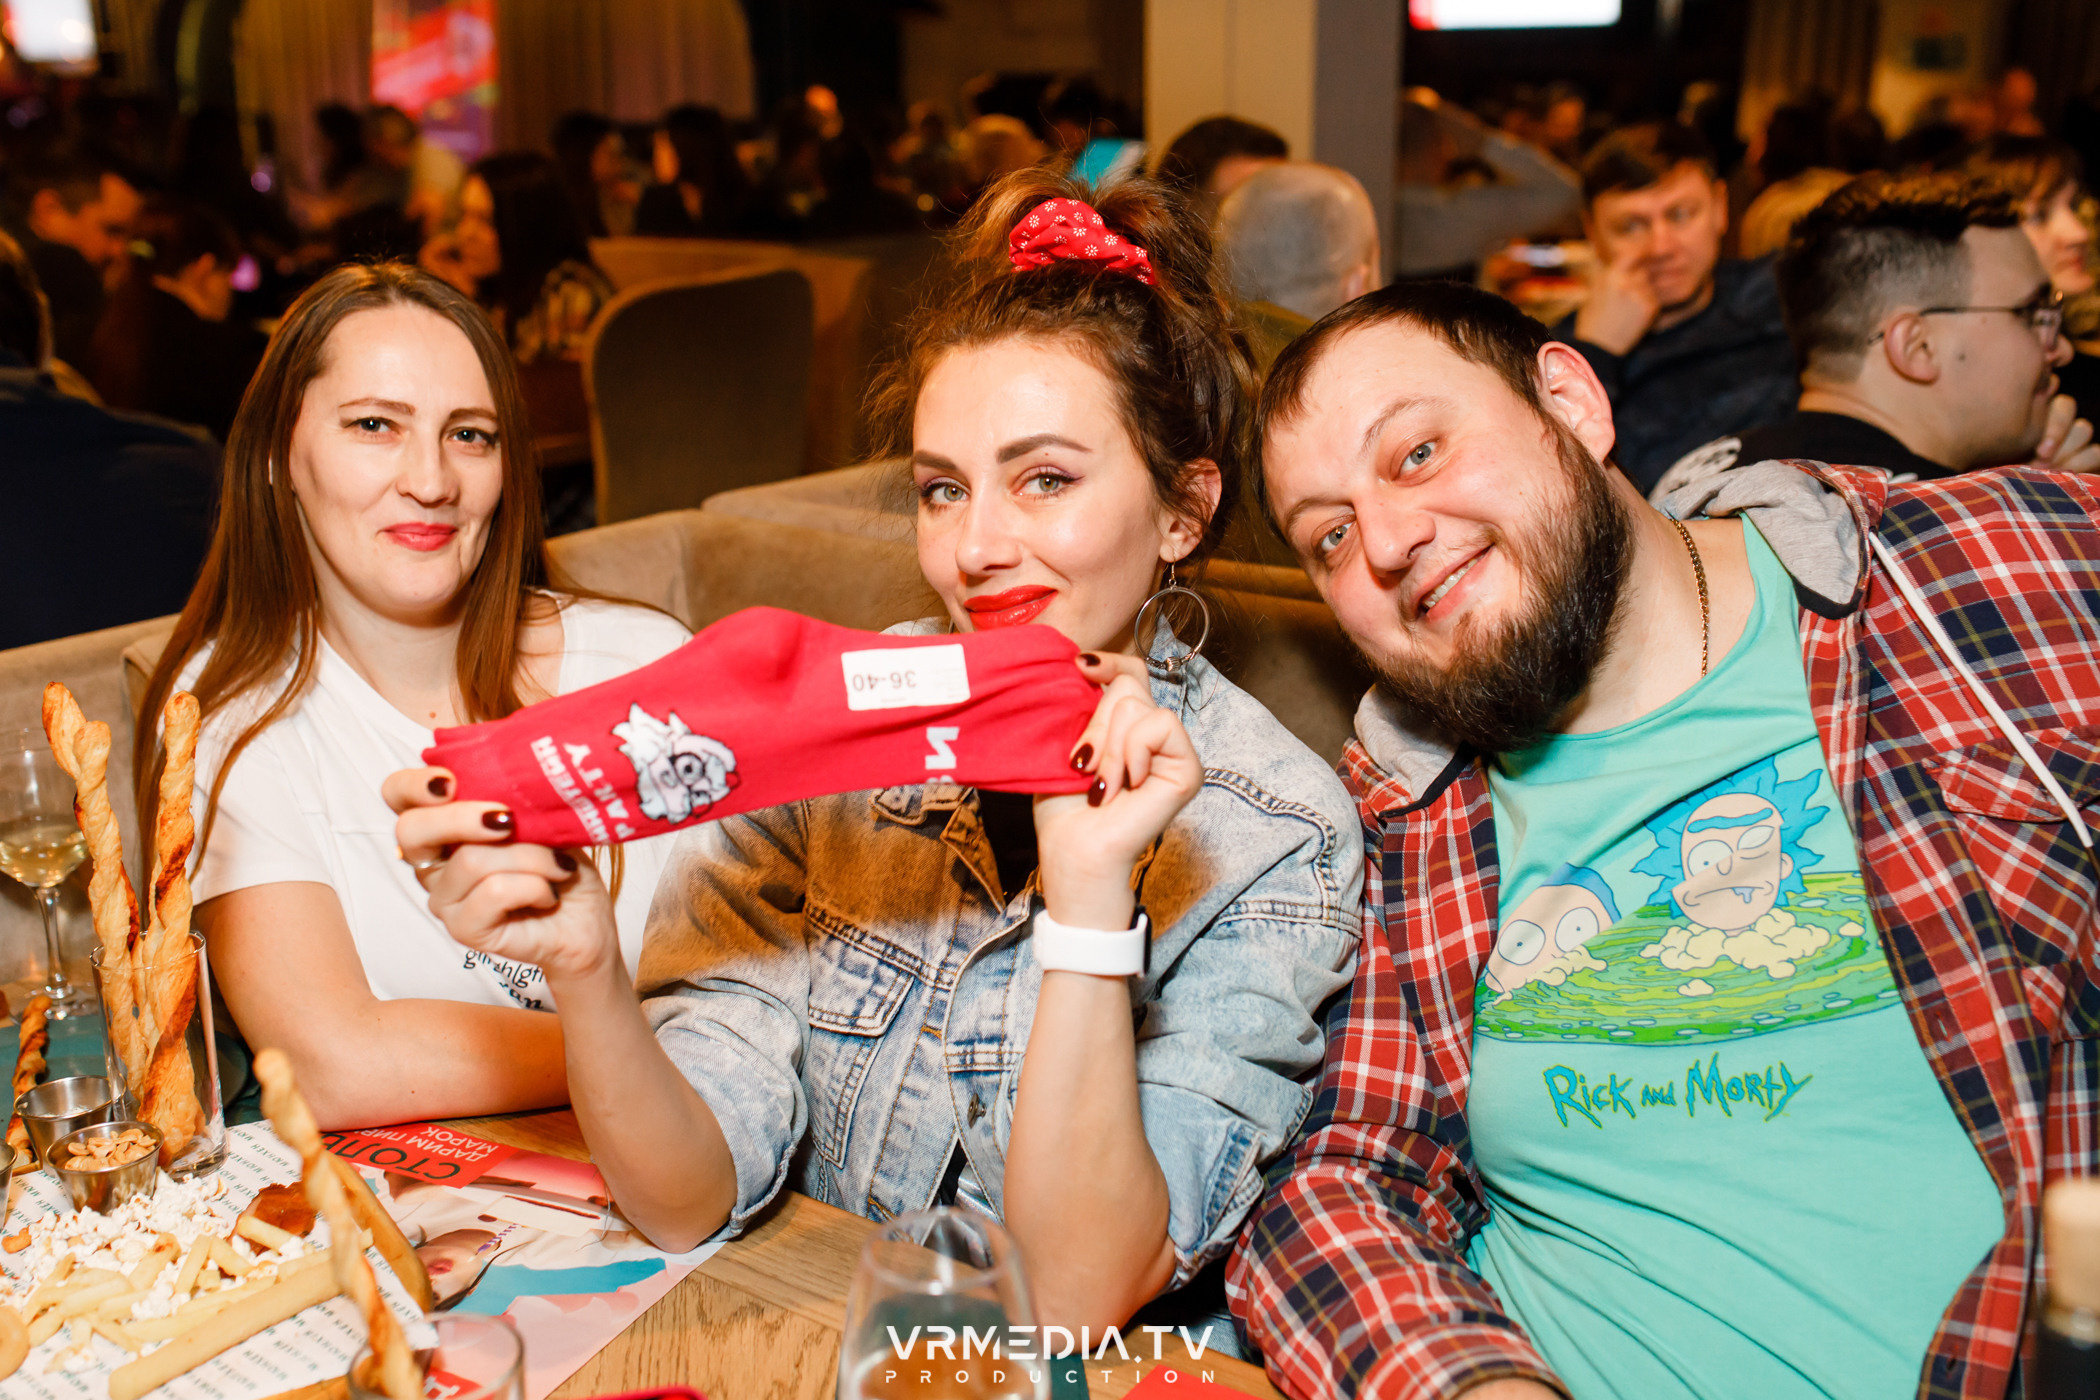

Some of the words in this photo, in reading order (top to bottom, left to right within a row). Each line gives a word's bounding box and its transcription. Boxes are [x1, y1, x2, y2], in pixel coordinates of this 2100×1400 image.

[852, 670, 917, 692] 36-40
[563, 743, 636, 839] PARTY
[406, 1135, 489, 1162] ДАРИМ
[420, 1126, 499, 1154] МАРОК
